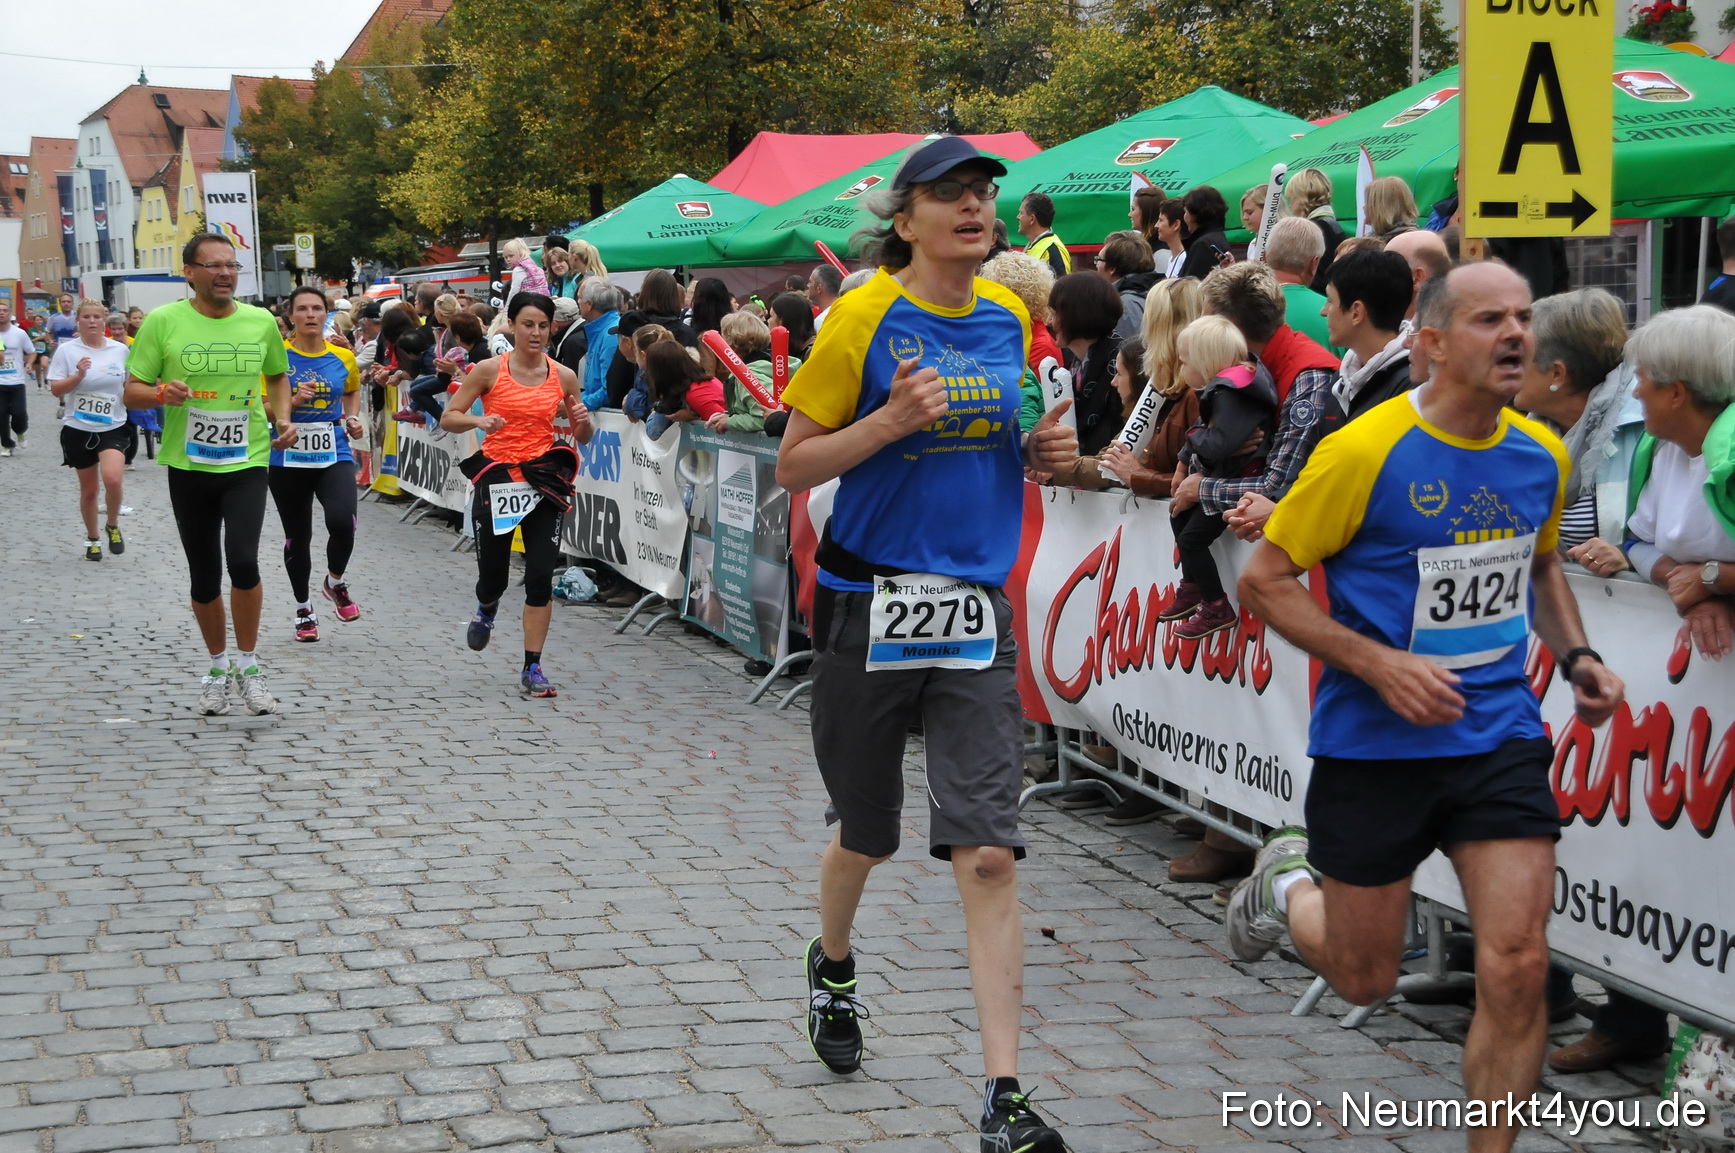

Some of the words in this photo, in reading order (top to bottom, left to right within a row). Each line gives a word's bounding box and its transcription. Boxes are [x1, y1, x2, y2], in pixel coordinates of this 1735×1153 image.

[1497, 42, 1581, 175] A
[1030, 178, 1188, 194] Lammsbäu
[898, 347, 918, 355] Jahre
[742, 369, 760, 387] BKK
[757, 385, 776, 404] Audi
[78, 397, 112, 415] 2168
[943, 406, 981, 417] eptember
[983, 405, 1001, 413] 2014
[211, 415, 241, 423] Neumarkt
[193, 421, 244, 445] 2245
[198, 447, 236, 459] Wolfgang
[291, 453, 330, 462] Anna-Maria
[1422, 484, 1433, 492] 15
[1418, 494, 1441, 503] Jahre
[1421, 558, 1466, 573] PARTL
[1469, 552, 1520, 568] Neumarkt
[877, 584, 918, 596] PRTL
[920, 580, 967, 596] Neumarkt
[1429, 567, 1522, 623] 3424
[884, 594, 984, 640] 2279
[902, 645, 961, 658] Monika
[1112, 702, 1229, 775] Ostbayerns
[1234, 741, 1293, 802] Radio
